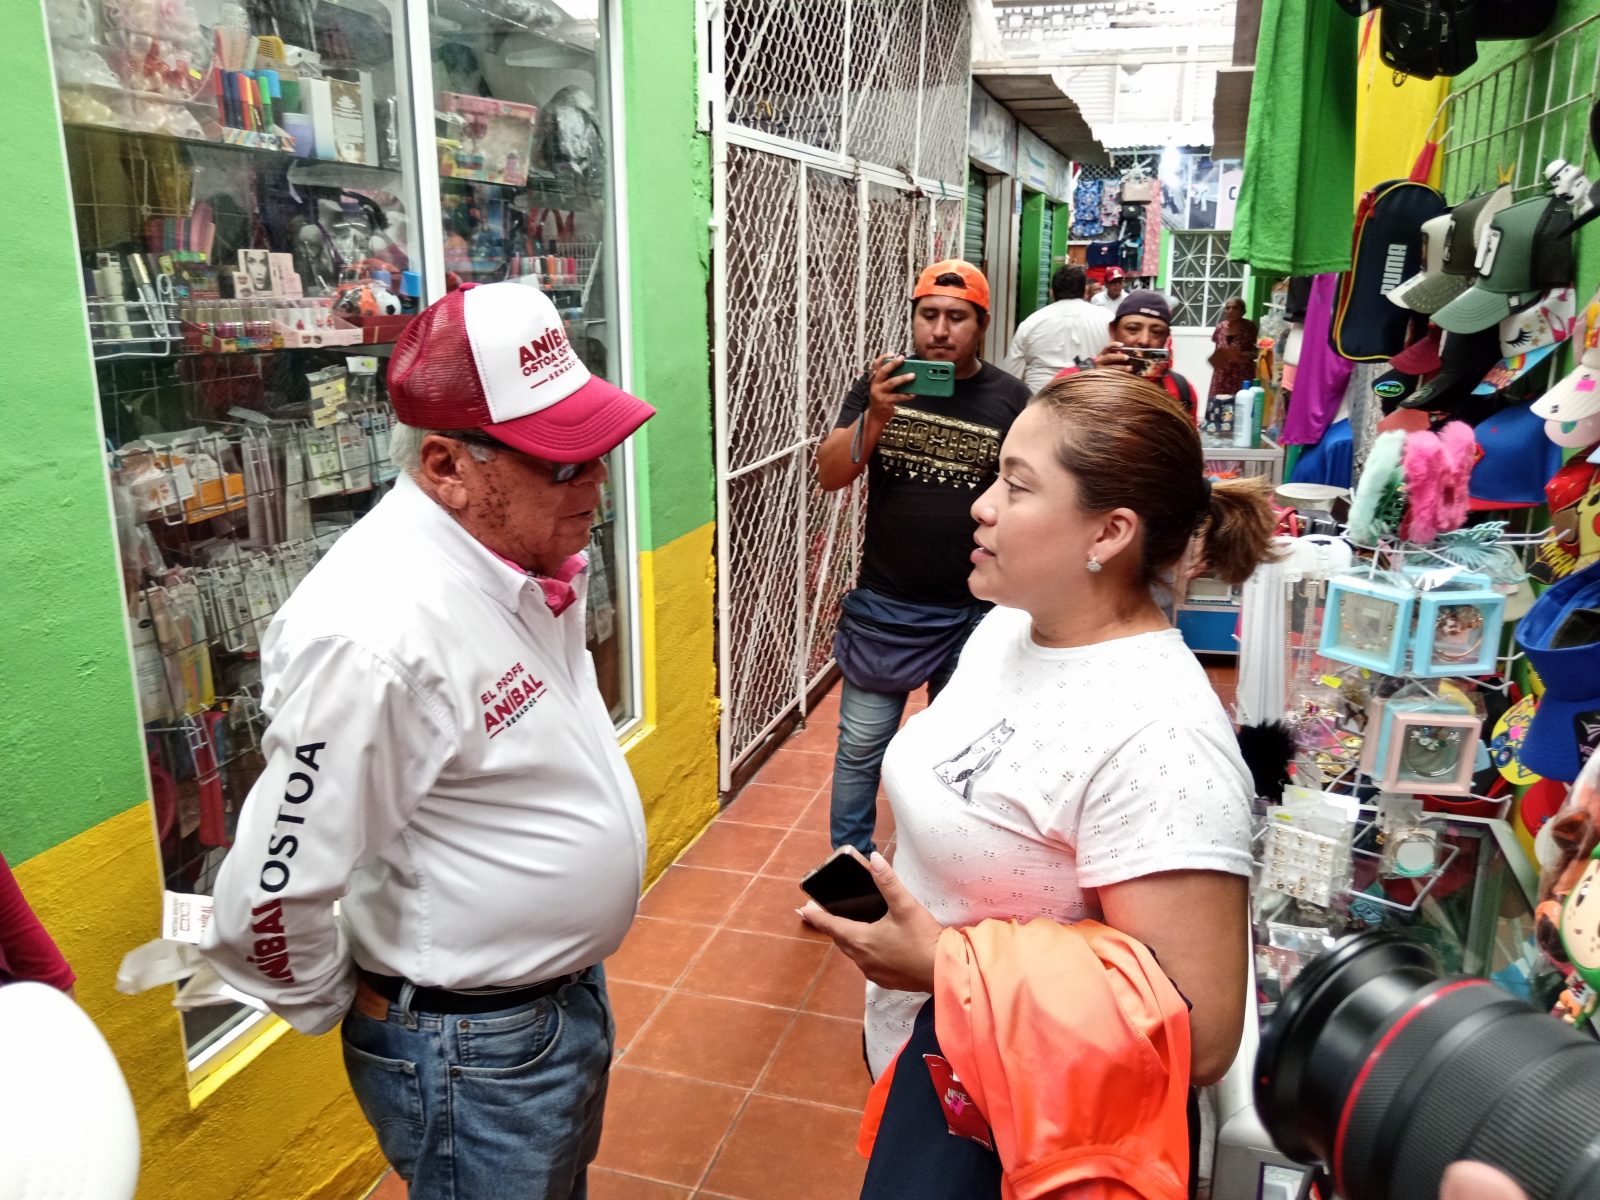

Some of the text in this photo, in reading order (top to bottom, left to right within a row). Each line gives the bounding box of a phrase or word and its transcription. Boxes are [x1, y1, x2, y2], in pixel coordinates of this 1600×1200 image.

[1379, 243, 1408, 295] PUMA
[522, 352, 559, 377] OSTOA
[480, 661, 524, 705] EL PROFE
[484, 673, 543, 733] ANÍBAL
[259, 741, 327, 894] OSTOA
